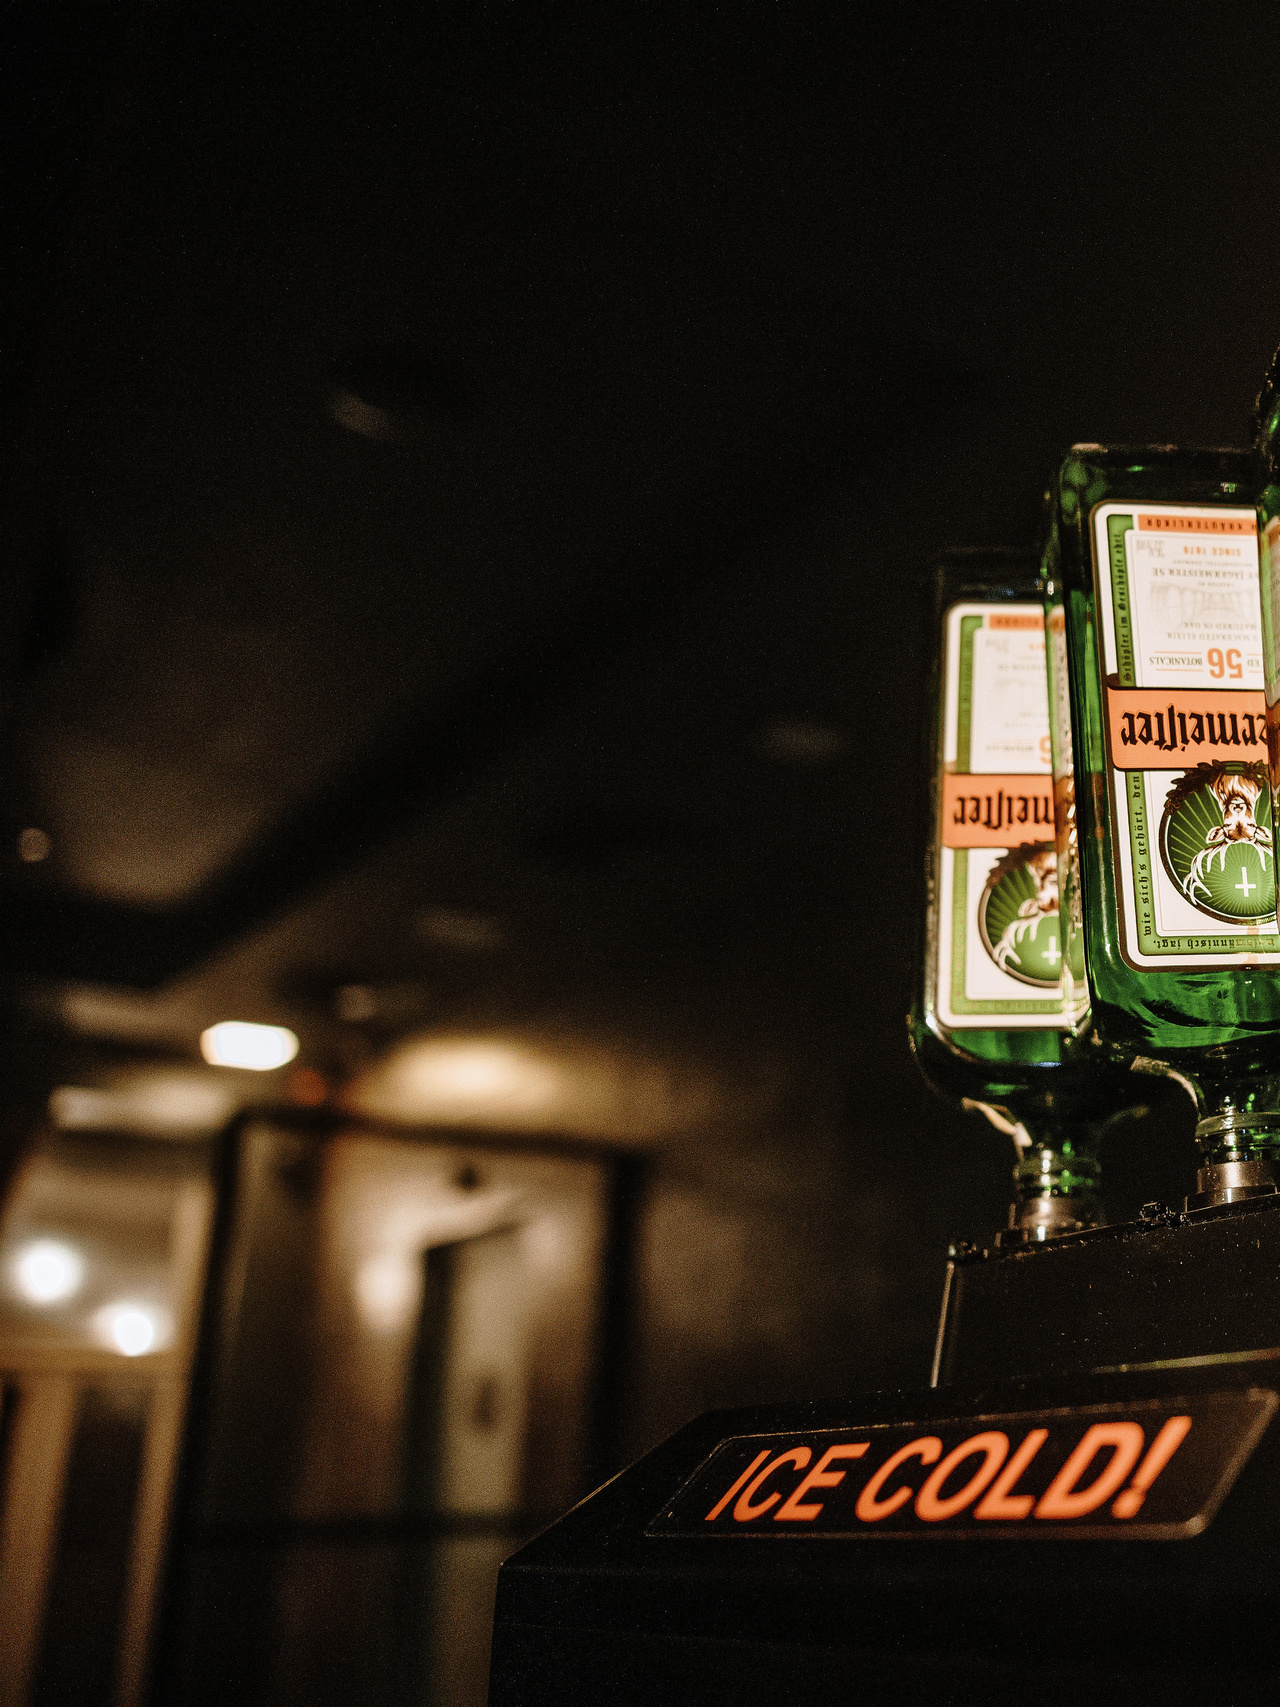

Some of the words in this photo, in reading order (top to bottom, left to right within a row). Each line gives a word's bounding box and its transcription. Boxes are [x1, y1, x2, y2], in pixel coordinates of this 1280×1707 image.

[1149, 656, 1203, 666] BOTANICALS
[1206, 648, 1243, 679] 56
[1120, 705, 1267, 752] ermeister
[704, 1441, 871, 1523] ICE
[854, 1415, 1192, 1523] COLD!
